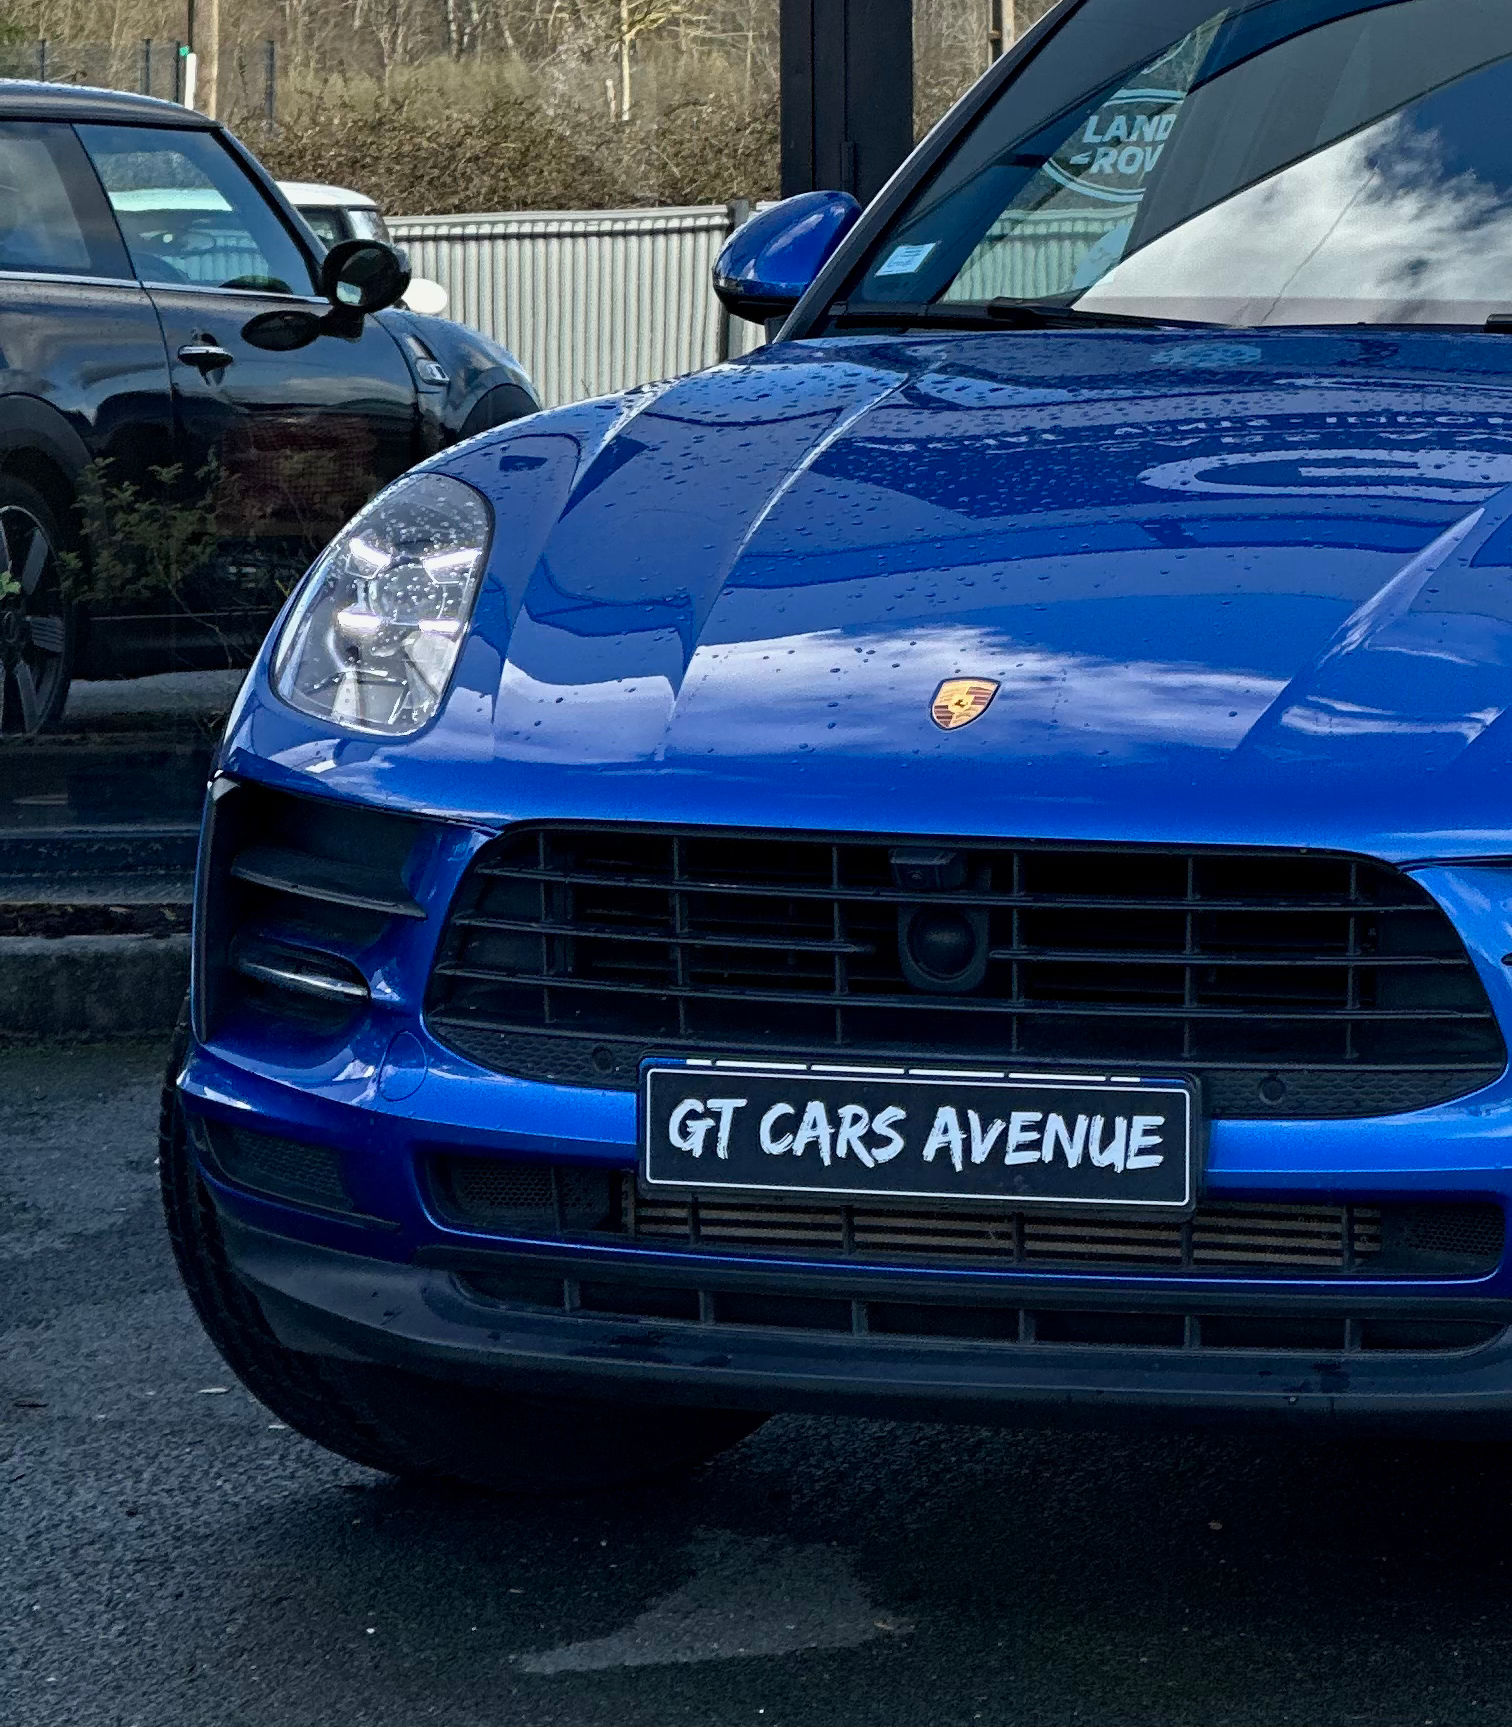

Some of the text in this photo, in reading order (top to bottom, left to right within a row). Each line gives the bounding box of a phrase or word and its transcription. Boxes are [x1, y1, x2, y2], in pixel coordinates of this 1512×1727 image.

[1083, 113, 1177, 143] LAND
[1088, 144, 1165, 175] ROV
[668, 1098, 1166, 1173] GT CARS AVENUE
